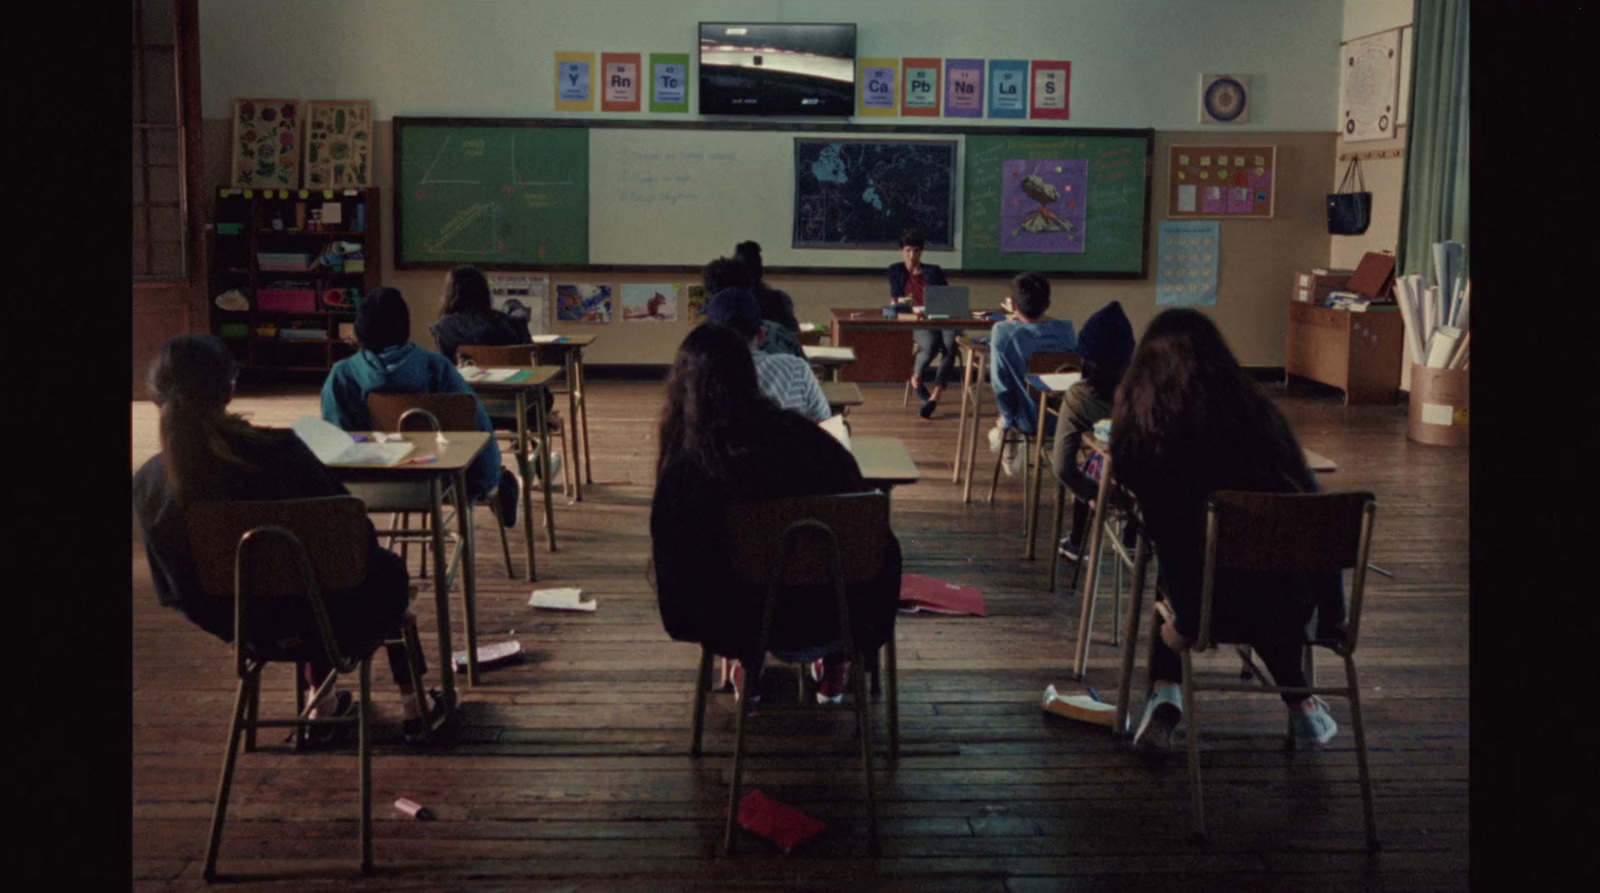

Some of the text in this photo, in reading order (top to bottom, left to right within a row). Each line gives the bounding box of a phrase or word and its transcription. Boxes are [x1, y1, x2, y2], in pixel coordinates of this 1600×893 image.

[569, 73, 579, 87] Y
[611, 75, 631, 88] Rn
[660, 75, 679, 89] Tc
[868, 78, 889, 94] Ca
[911, 80, 931, 93] Pb
[955, 81, 974, 94] Na
[999, 81, 1017, 95] La
[1044, 81, 1056, 95] S
